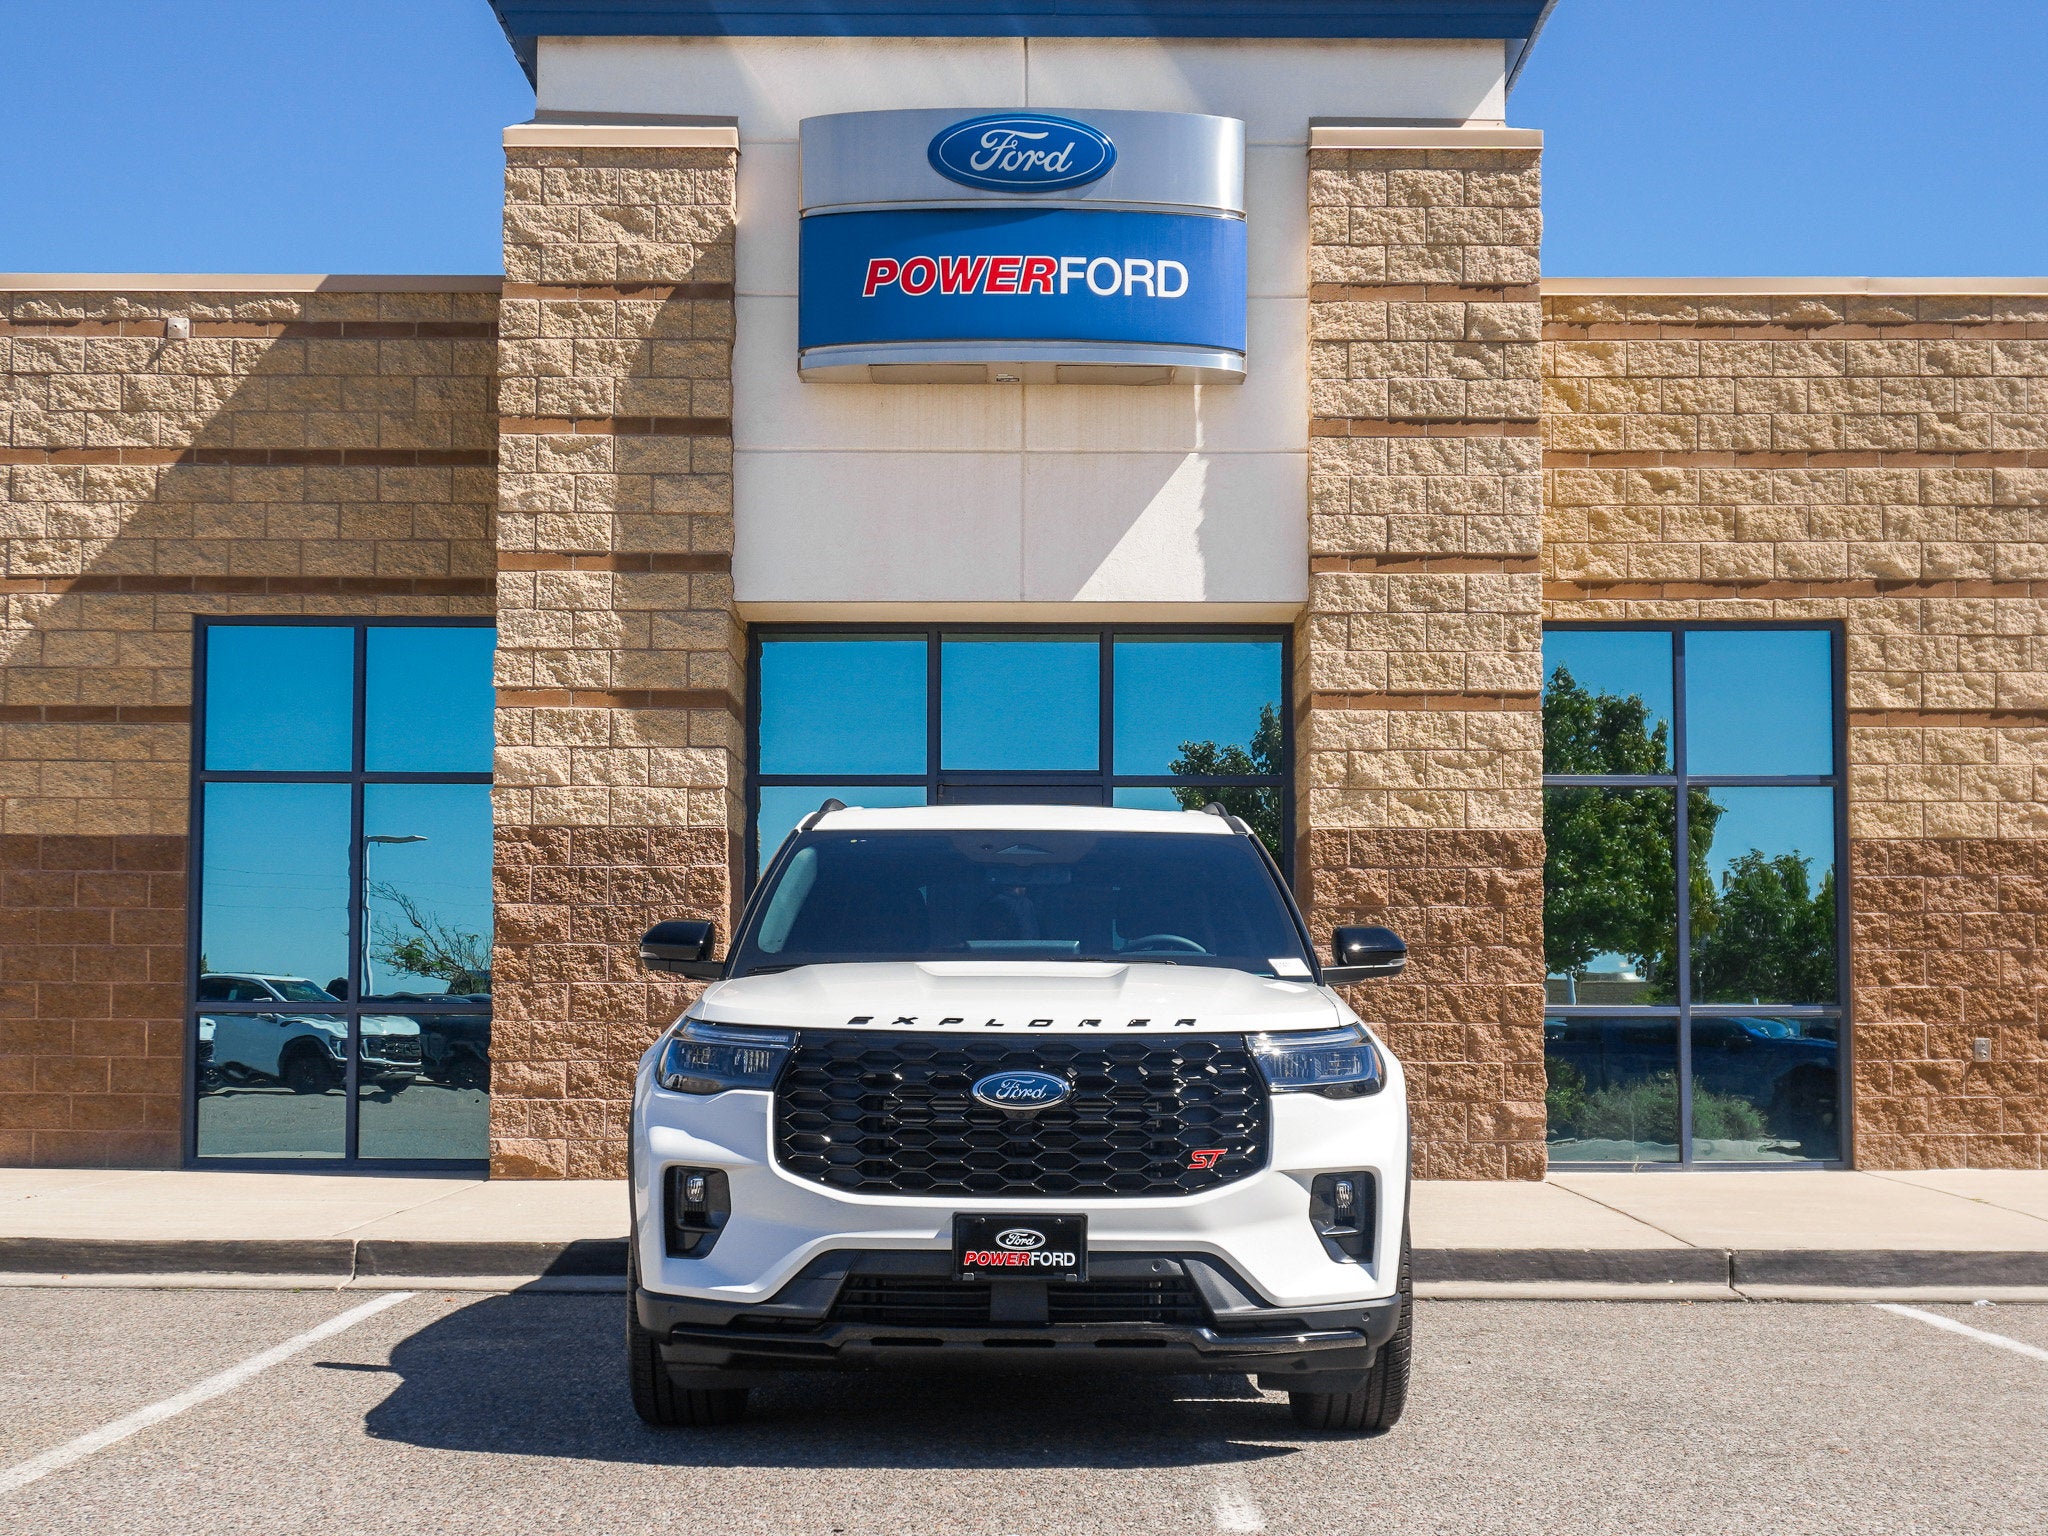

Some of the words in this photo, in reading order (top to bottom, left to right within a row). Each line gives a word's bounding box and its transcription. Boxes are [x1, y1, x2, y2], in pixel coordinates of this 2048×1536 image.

[970, 129, 1075, 173] Ford
[847, 1016, 1197, 1027] EXPLORER
[995, 1078, 1048, 1100] Ford
[1187, 1148, 1228, 1170] ST
[1005, 1232, 1035, 1246] Ford
